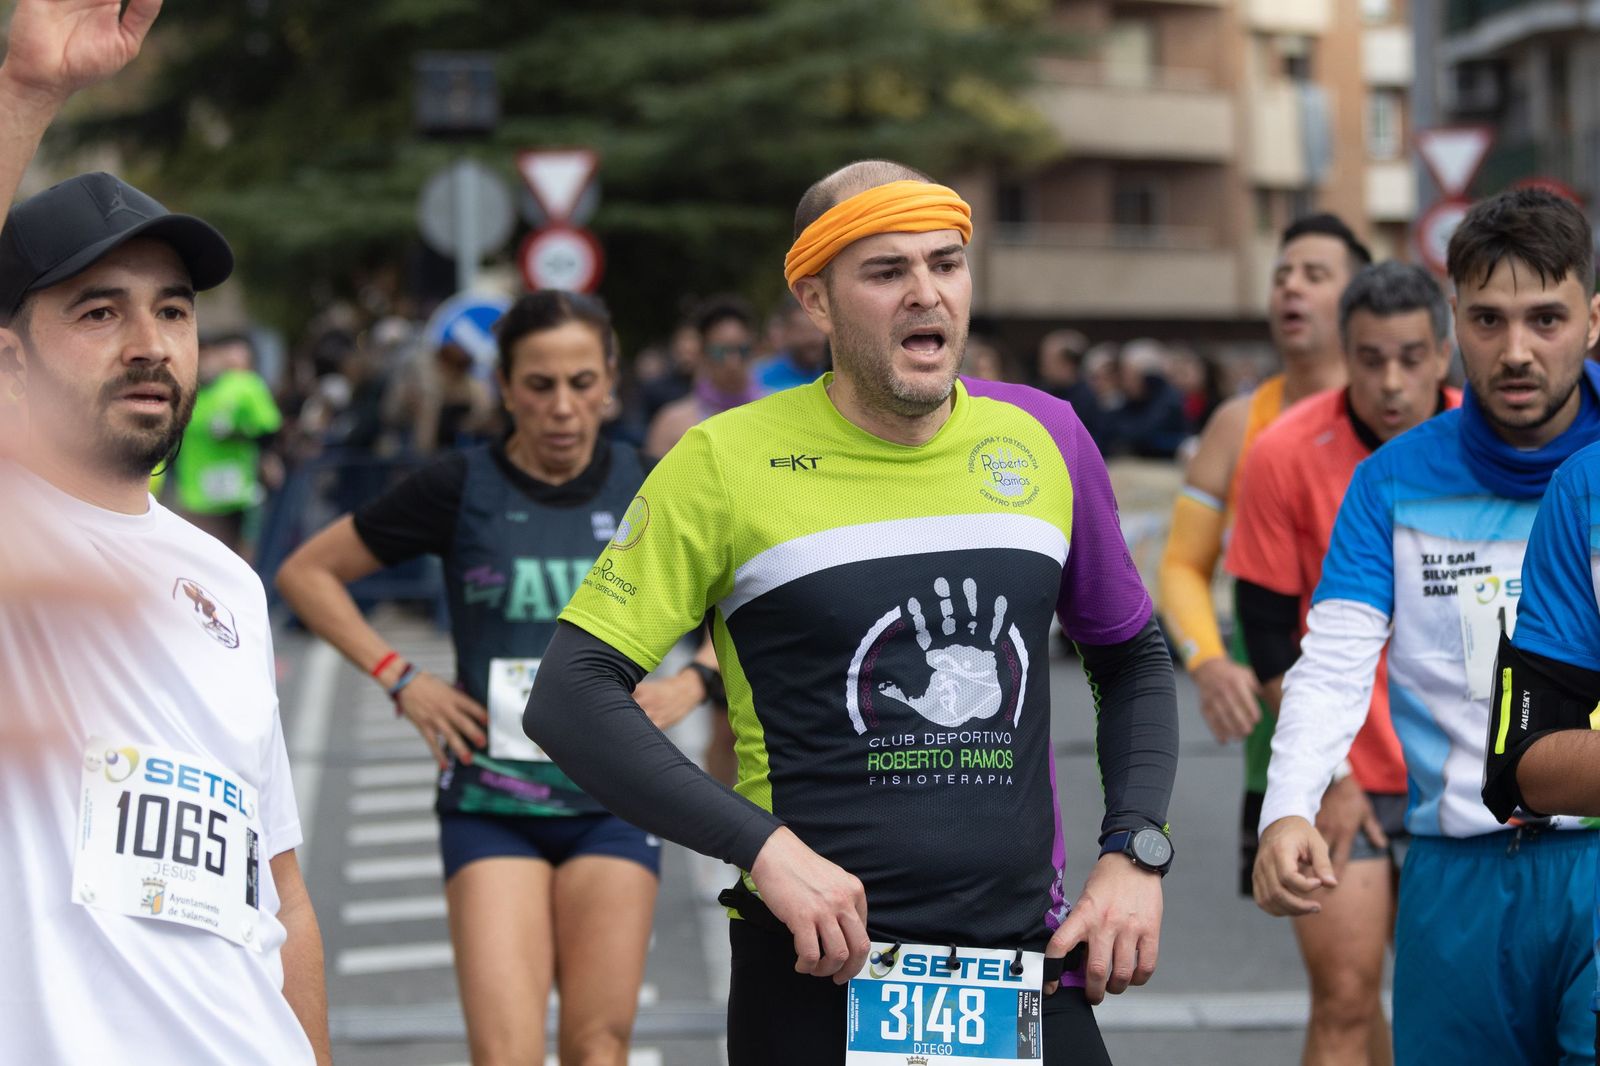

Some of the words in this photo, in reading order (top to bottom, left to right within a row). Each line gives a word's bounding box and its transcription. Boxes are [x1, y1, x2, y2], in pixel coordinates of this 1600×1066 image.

[770, 454, 821, 471] EKT
[981, 454, 1029, 471] Roberto
[992, 471, 1031, 487] Ramos
[979, 489, 1010, 507] CENTRO
[1421, 554, 1442, 566] XLI
[1447, 551, 1475, 565] SAN
[600, 558, 638, 596] Ramos
[869, 734, 915, 748] CLUB
[924, 731, 1012, 746] DEPORTIVO
[867, 749, 954, 771] ROBERTO
[960, 749, 1014, 770] RAMOS
[144, 758, 248, 817] SETEL
[869, 774, 1013, 786] FISIOTERAPIA
[116, 790, 228, 877] 1065
[902, 953, 1023, 983] SETEL
[880, 983, 985, 1045] 3148
[1031, 997, 1039, 1016] 3148
[913, 1043, 953, 1056] DIEGO
